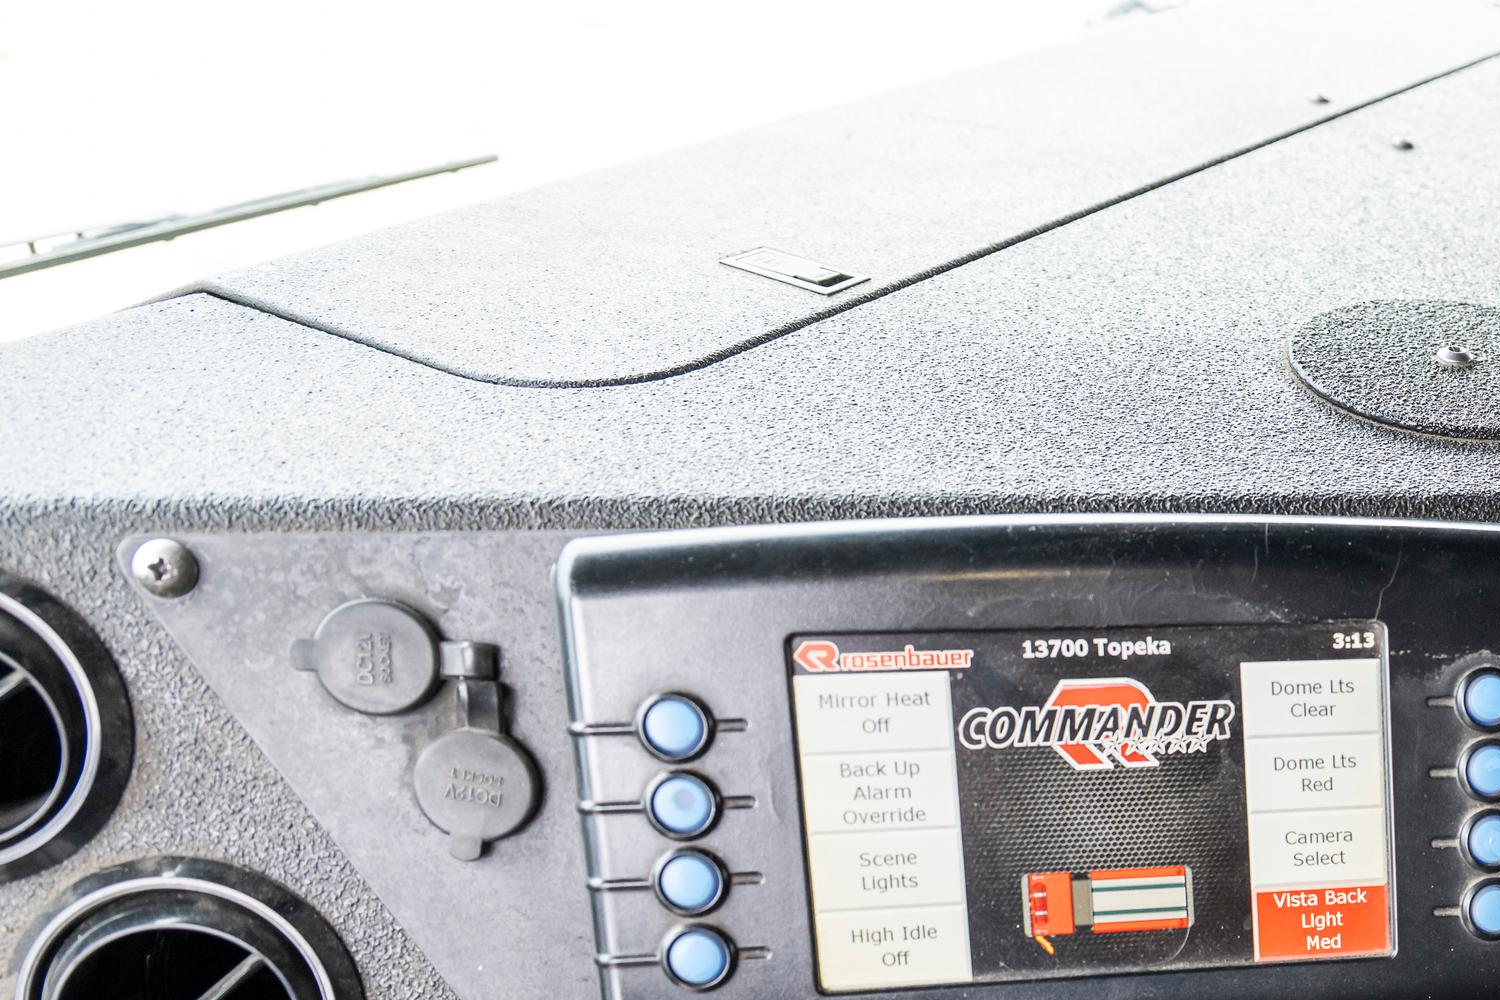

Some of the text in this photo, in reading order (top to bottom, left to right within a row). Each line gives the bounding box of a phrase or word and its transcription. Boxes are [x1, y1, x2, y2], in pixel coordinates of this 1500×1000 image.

[1022, 638, 1171, 659] 13700 Topeka
[1332, 633, 1375, 649] 3:13
[1270, 678, 1355, 696] Dome Lts
[818, 690, 930, 709] Mirror Heat
[1290, 701, 1336, 718] Clear
[862, 716, 890, 734] Off
[959, 700, 1234, 750] COMMANDER
[840, 760, 920, 778] Back Up
[1274, 754, 1357, 772] Dome Lts
[854, 784, 912, 800] Alarm
[1302, 776, 1334, 792] Red
[842, 806, 926, 824] Override
[1284, 828, 1353, 845] Camera
[860, 850, 918, 866] Scene
[1293, 850, 1346, 866] Select
[861, 872, 918, 892] Lights
[1274, 888, 1367, 908] Vista Back
[1301, 910, 1344, 930] Light
[851, 924, 938, 944] High Idle
[1306, 934, 1342, 950] Med
[882, 950, 910, 968] Off
